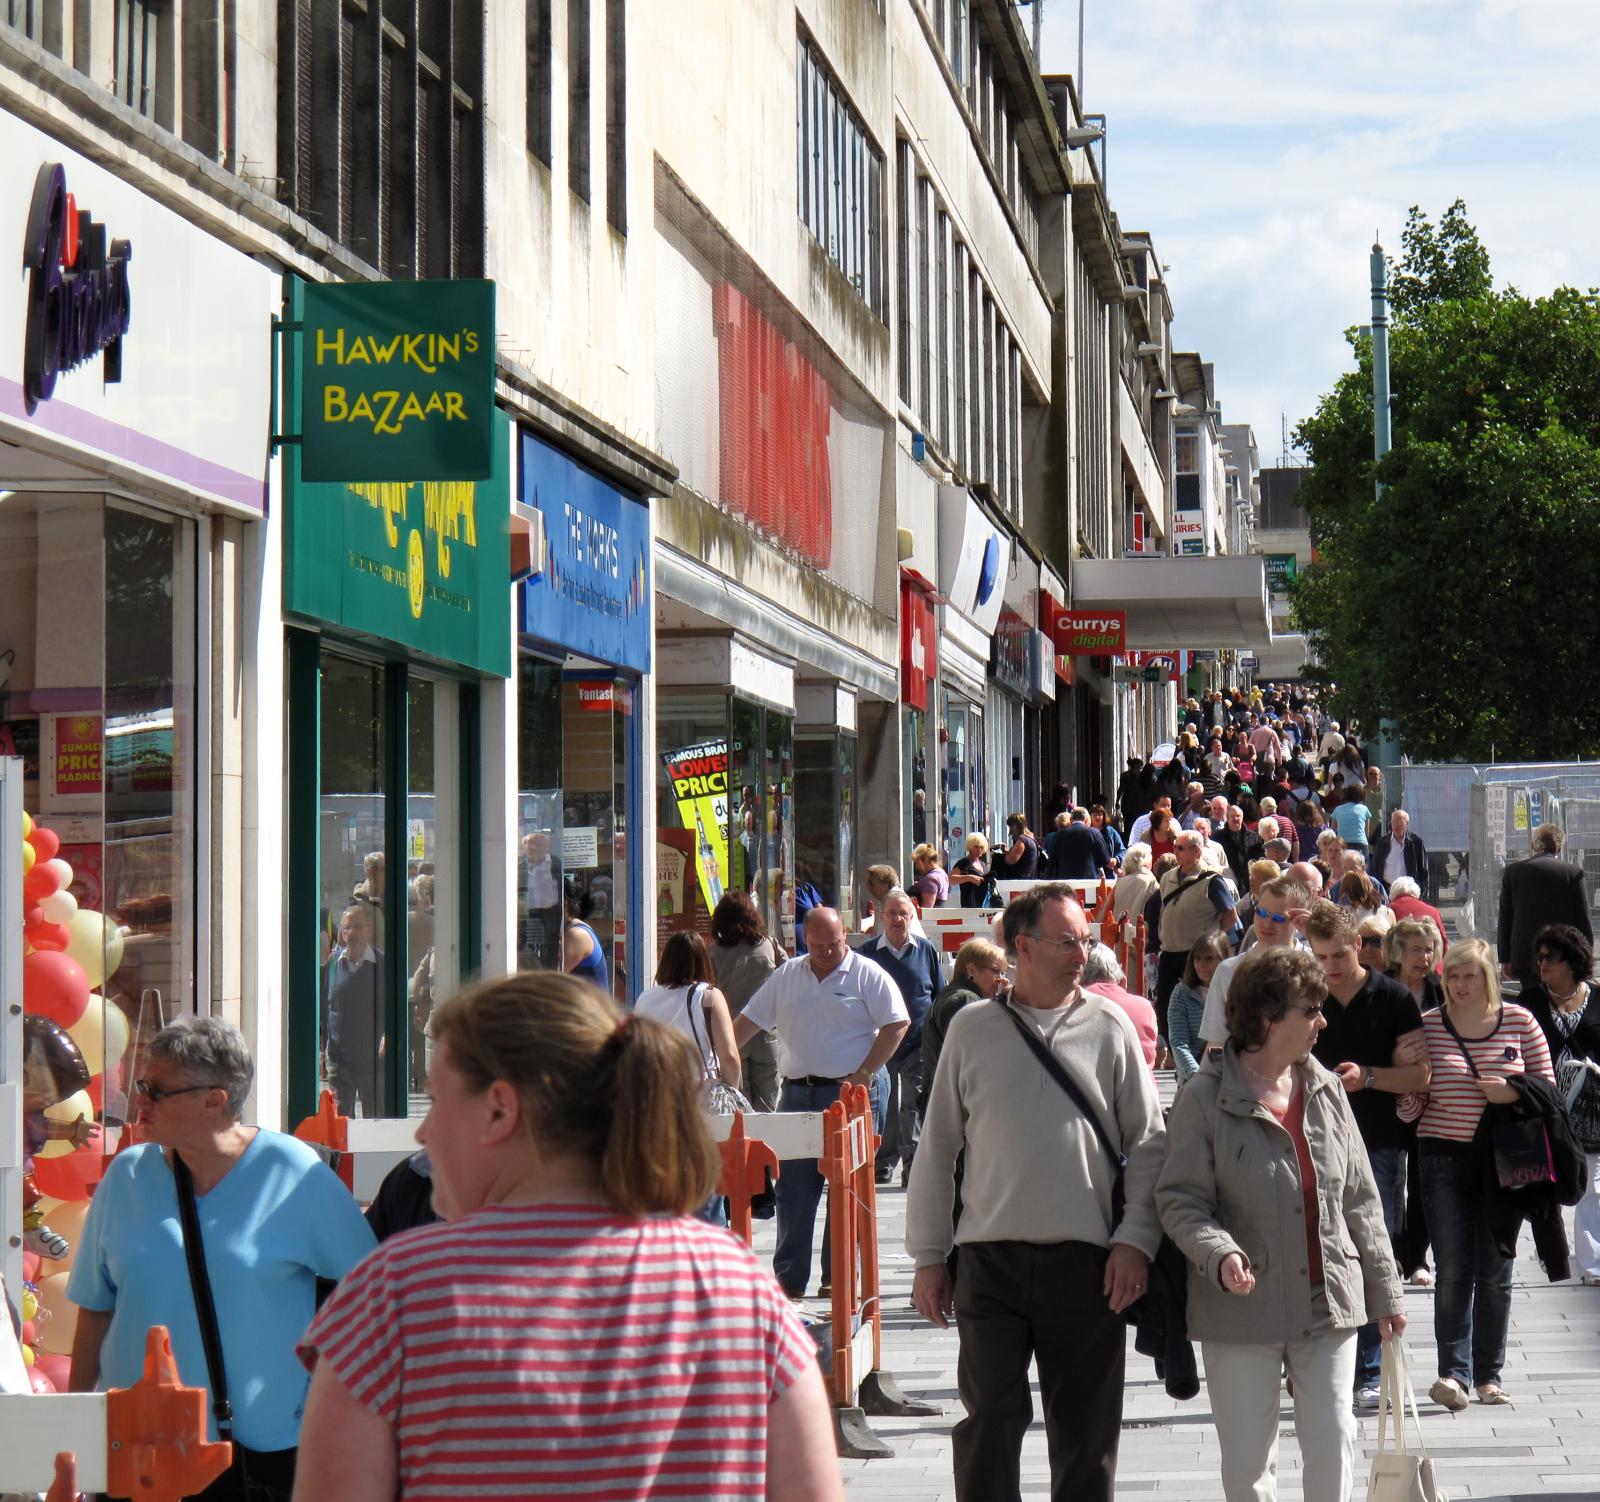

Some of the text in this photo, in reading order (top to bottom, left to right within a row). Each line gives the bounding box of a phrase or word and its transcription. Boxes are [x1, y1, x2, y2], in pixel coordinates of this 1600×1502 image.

[316, 328, 479, 373] HAWKIN'S
[324, 385, 468, 434] BAZAAR
[1174, 514, 1185, 523] LL
[564, 501, 582, 562] THE
[1058, 617, 1120, 632] Currys
[59, 754, 103, 770] PRIC
[664, 748, 704, 763] FAMOUS
[58, 772, 103, 782] MADNES
